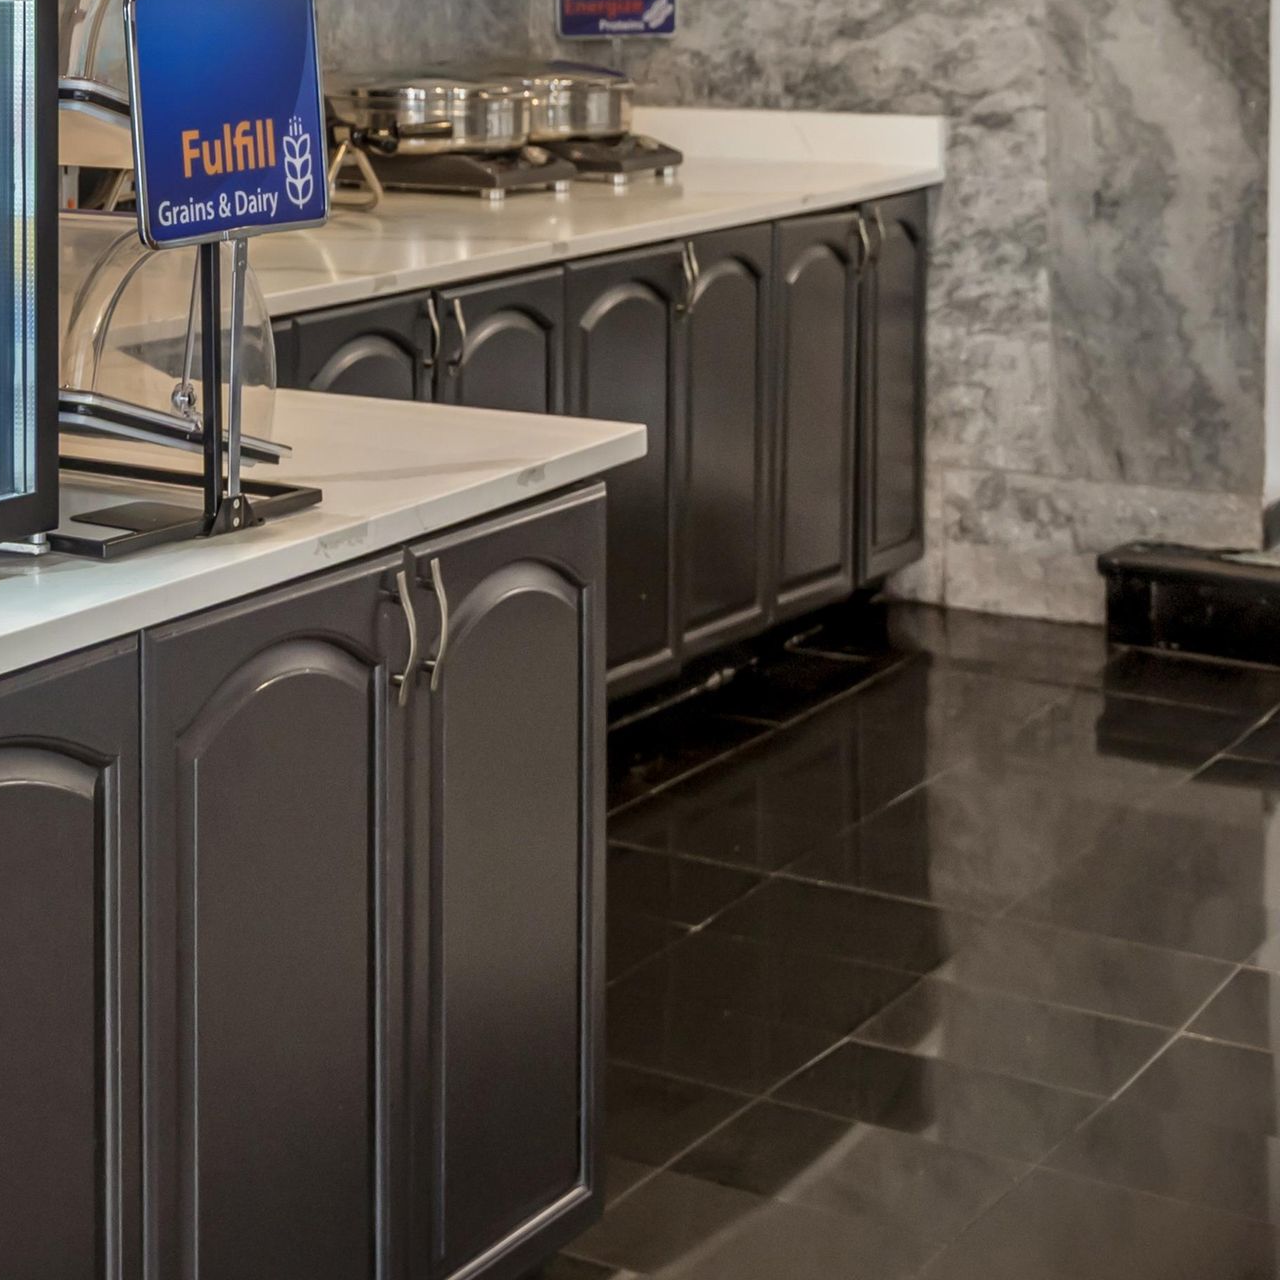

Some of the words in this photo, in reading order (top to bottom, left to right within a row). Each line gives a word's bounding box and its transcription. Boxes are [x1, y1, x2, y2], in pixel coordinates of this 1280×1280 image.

[182, 118, 276, 179] Fulfill
[158, 196, 214, 227] Grains
[218, 192, 232, 218] &
[234, 187, 279, 218] Dairy
